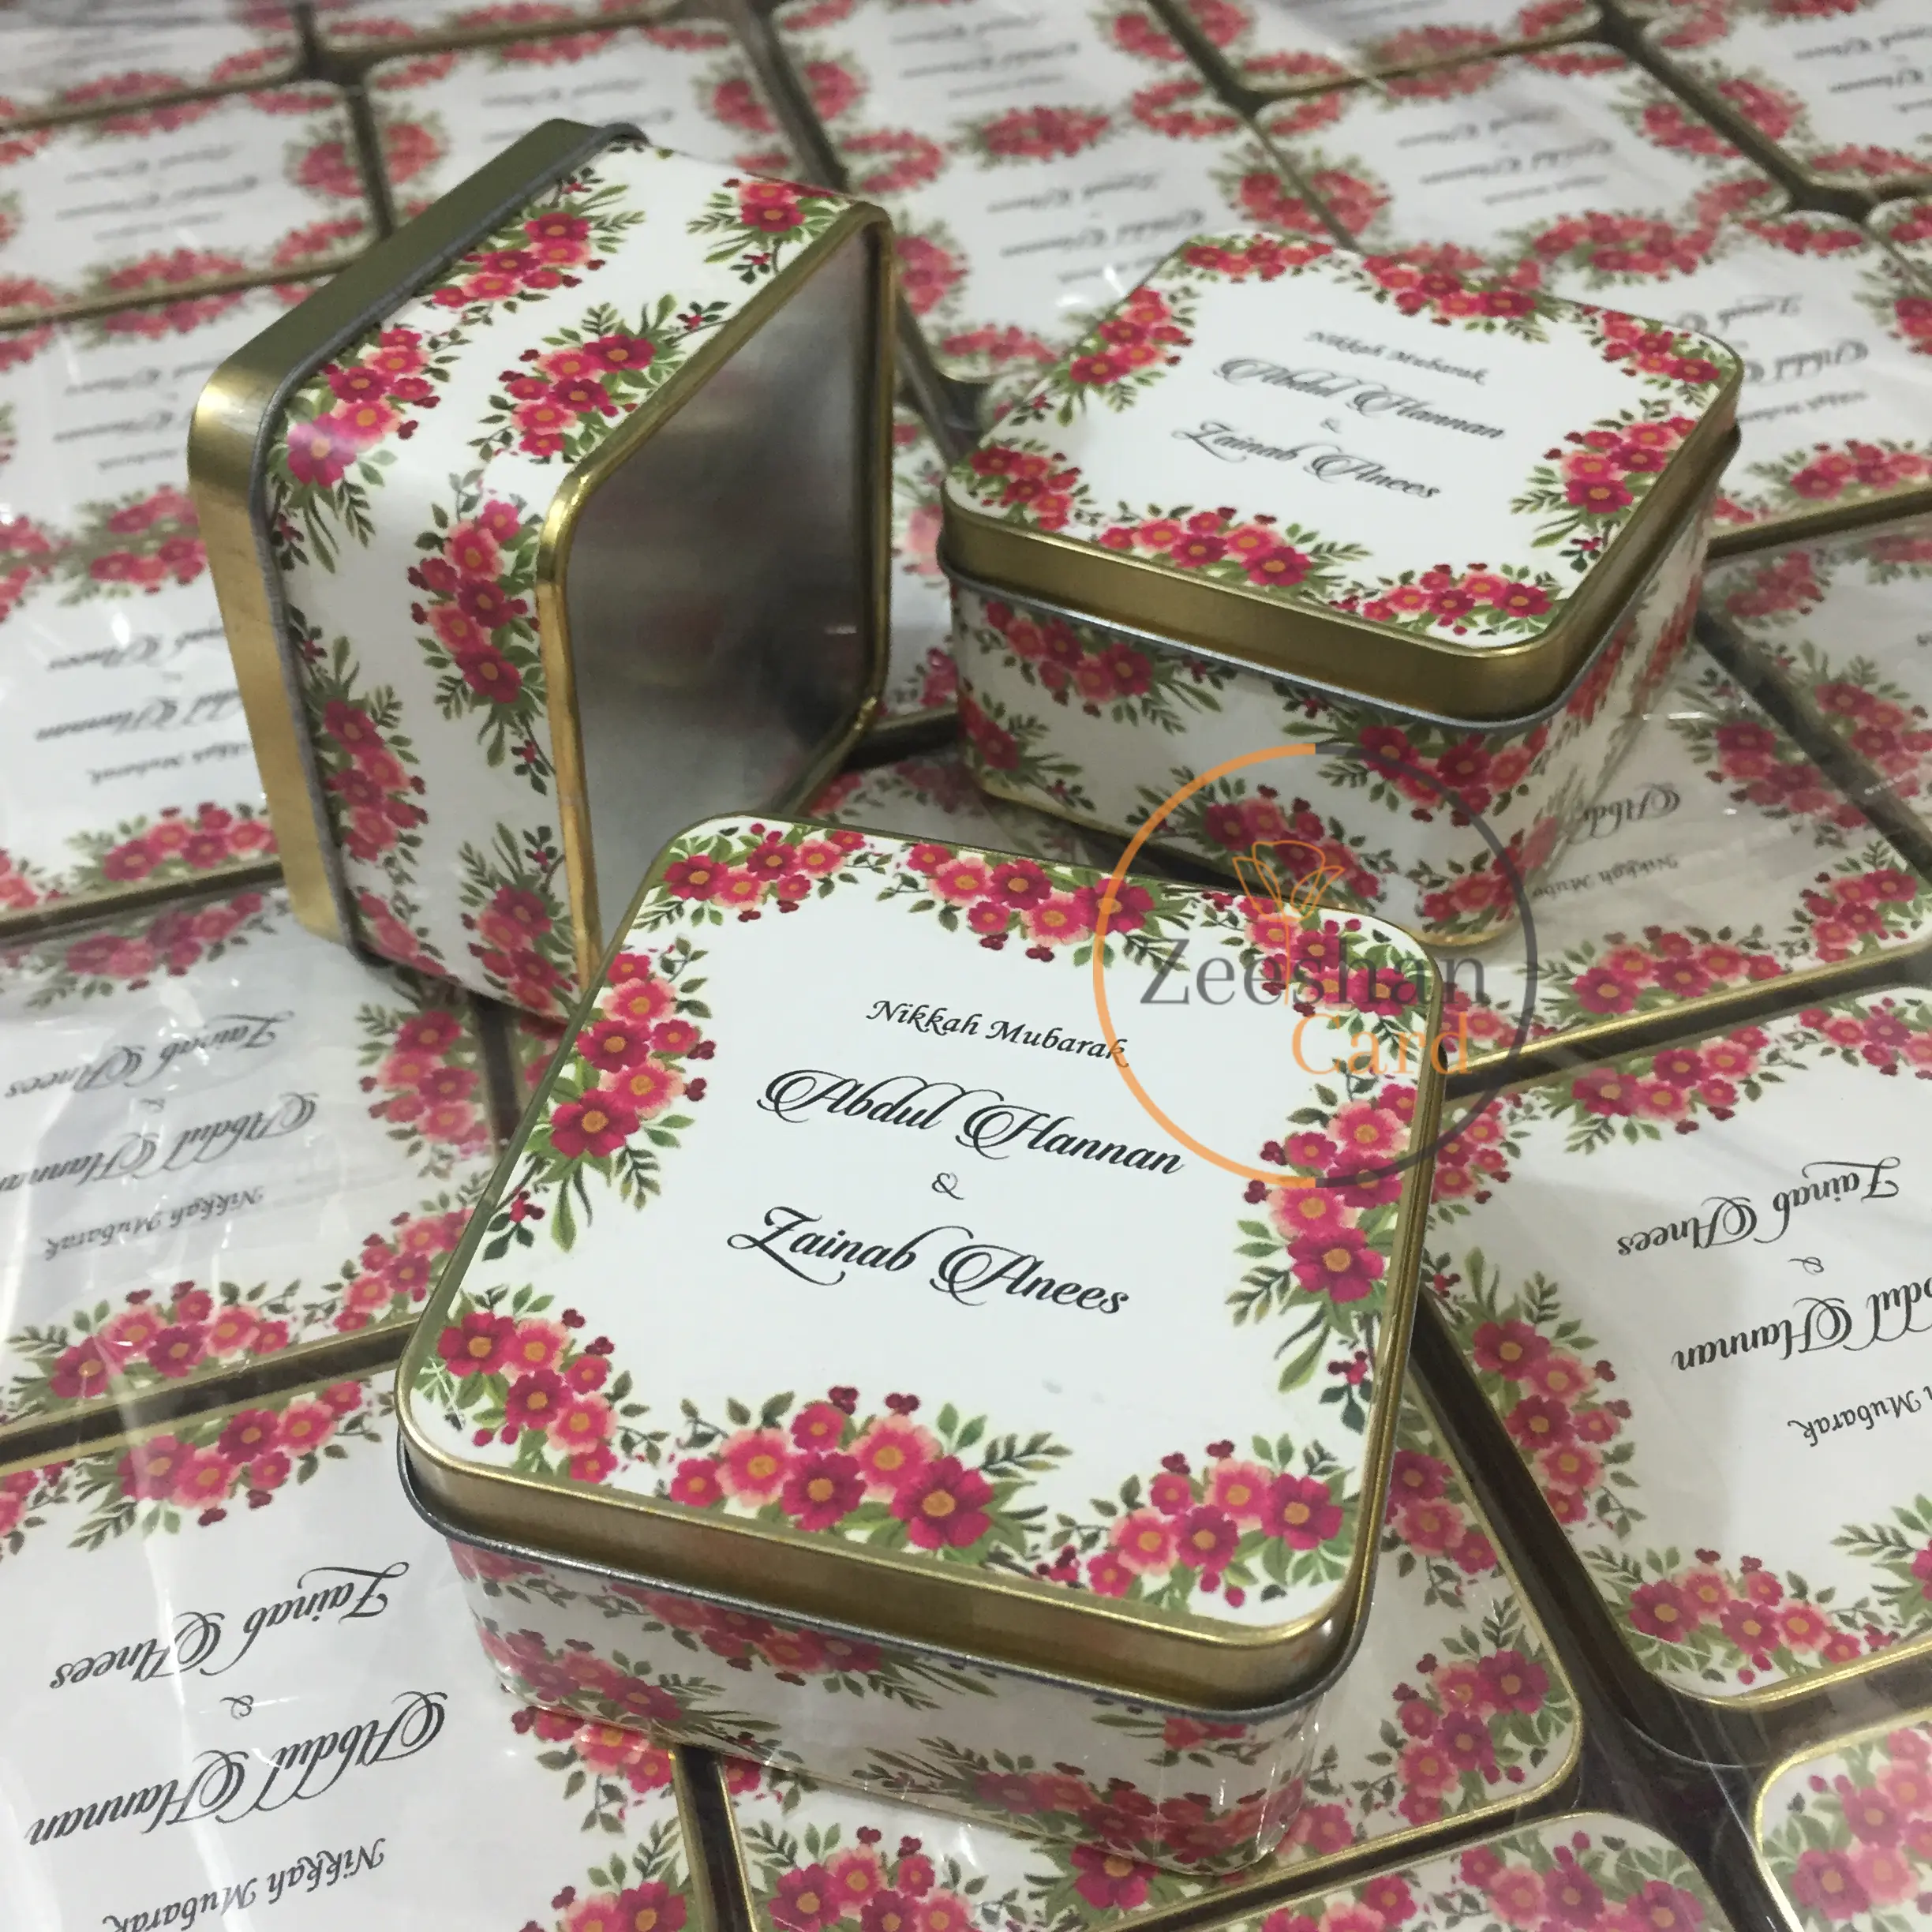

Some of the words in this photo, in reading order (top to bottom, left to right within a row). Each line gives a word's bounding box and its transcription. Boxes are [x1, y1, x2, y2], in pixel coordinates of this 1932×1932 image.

[1171, 420, 1342, 463] Zainab
[1303, 454, 1440, 499] Anees
[866, 999, 980, 1037] Nikkah
[986, 1019, 1130, 1069] Mubarak
[756, 1069, 1005, 1130] Abdul
[955, 1103, 1187, 1176] Hannan
[169, 1185, 264, 1228] Nikkah
[931, 1171, 965, 1200] &
[1754, 1156, 1900, 1244] Zainab
[44, 1211, 162, 1261] Mubarak
[726, 1205, 975, 1287] Zainab
[929, 1244, 1130, 1315] Anees
[1617, 1196, 1758, 1256] Anees
[1788, 1256, 1824, 1275] &
[1671, 1297, 1852, 1371] Hannan
[1788, 1390, 1922, 1447] Mubarak
[50, 1611, 225, 1690] Anees
[200, 1561, 410, 1677] Zainab
[220, 1694, 254, 1720] &
[215, 1690, 448, 1824] Abdul
[25, 1749, 249, 1845] Hannan
[103, 1878, 258, 1932] Mubarak
[267, 1837, 386, 1905] Nikkah
